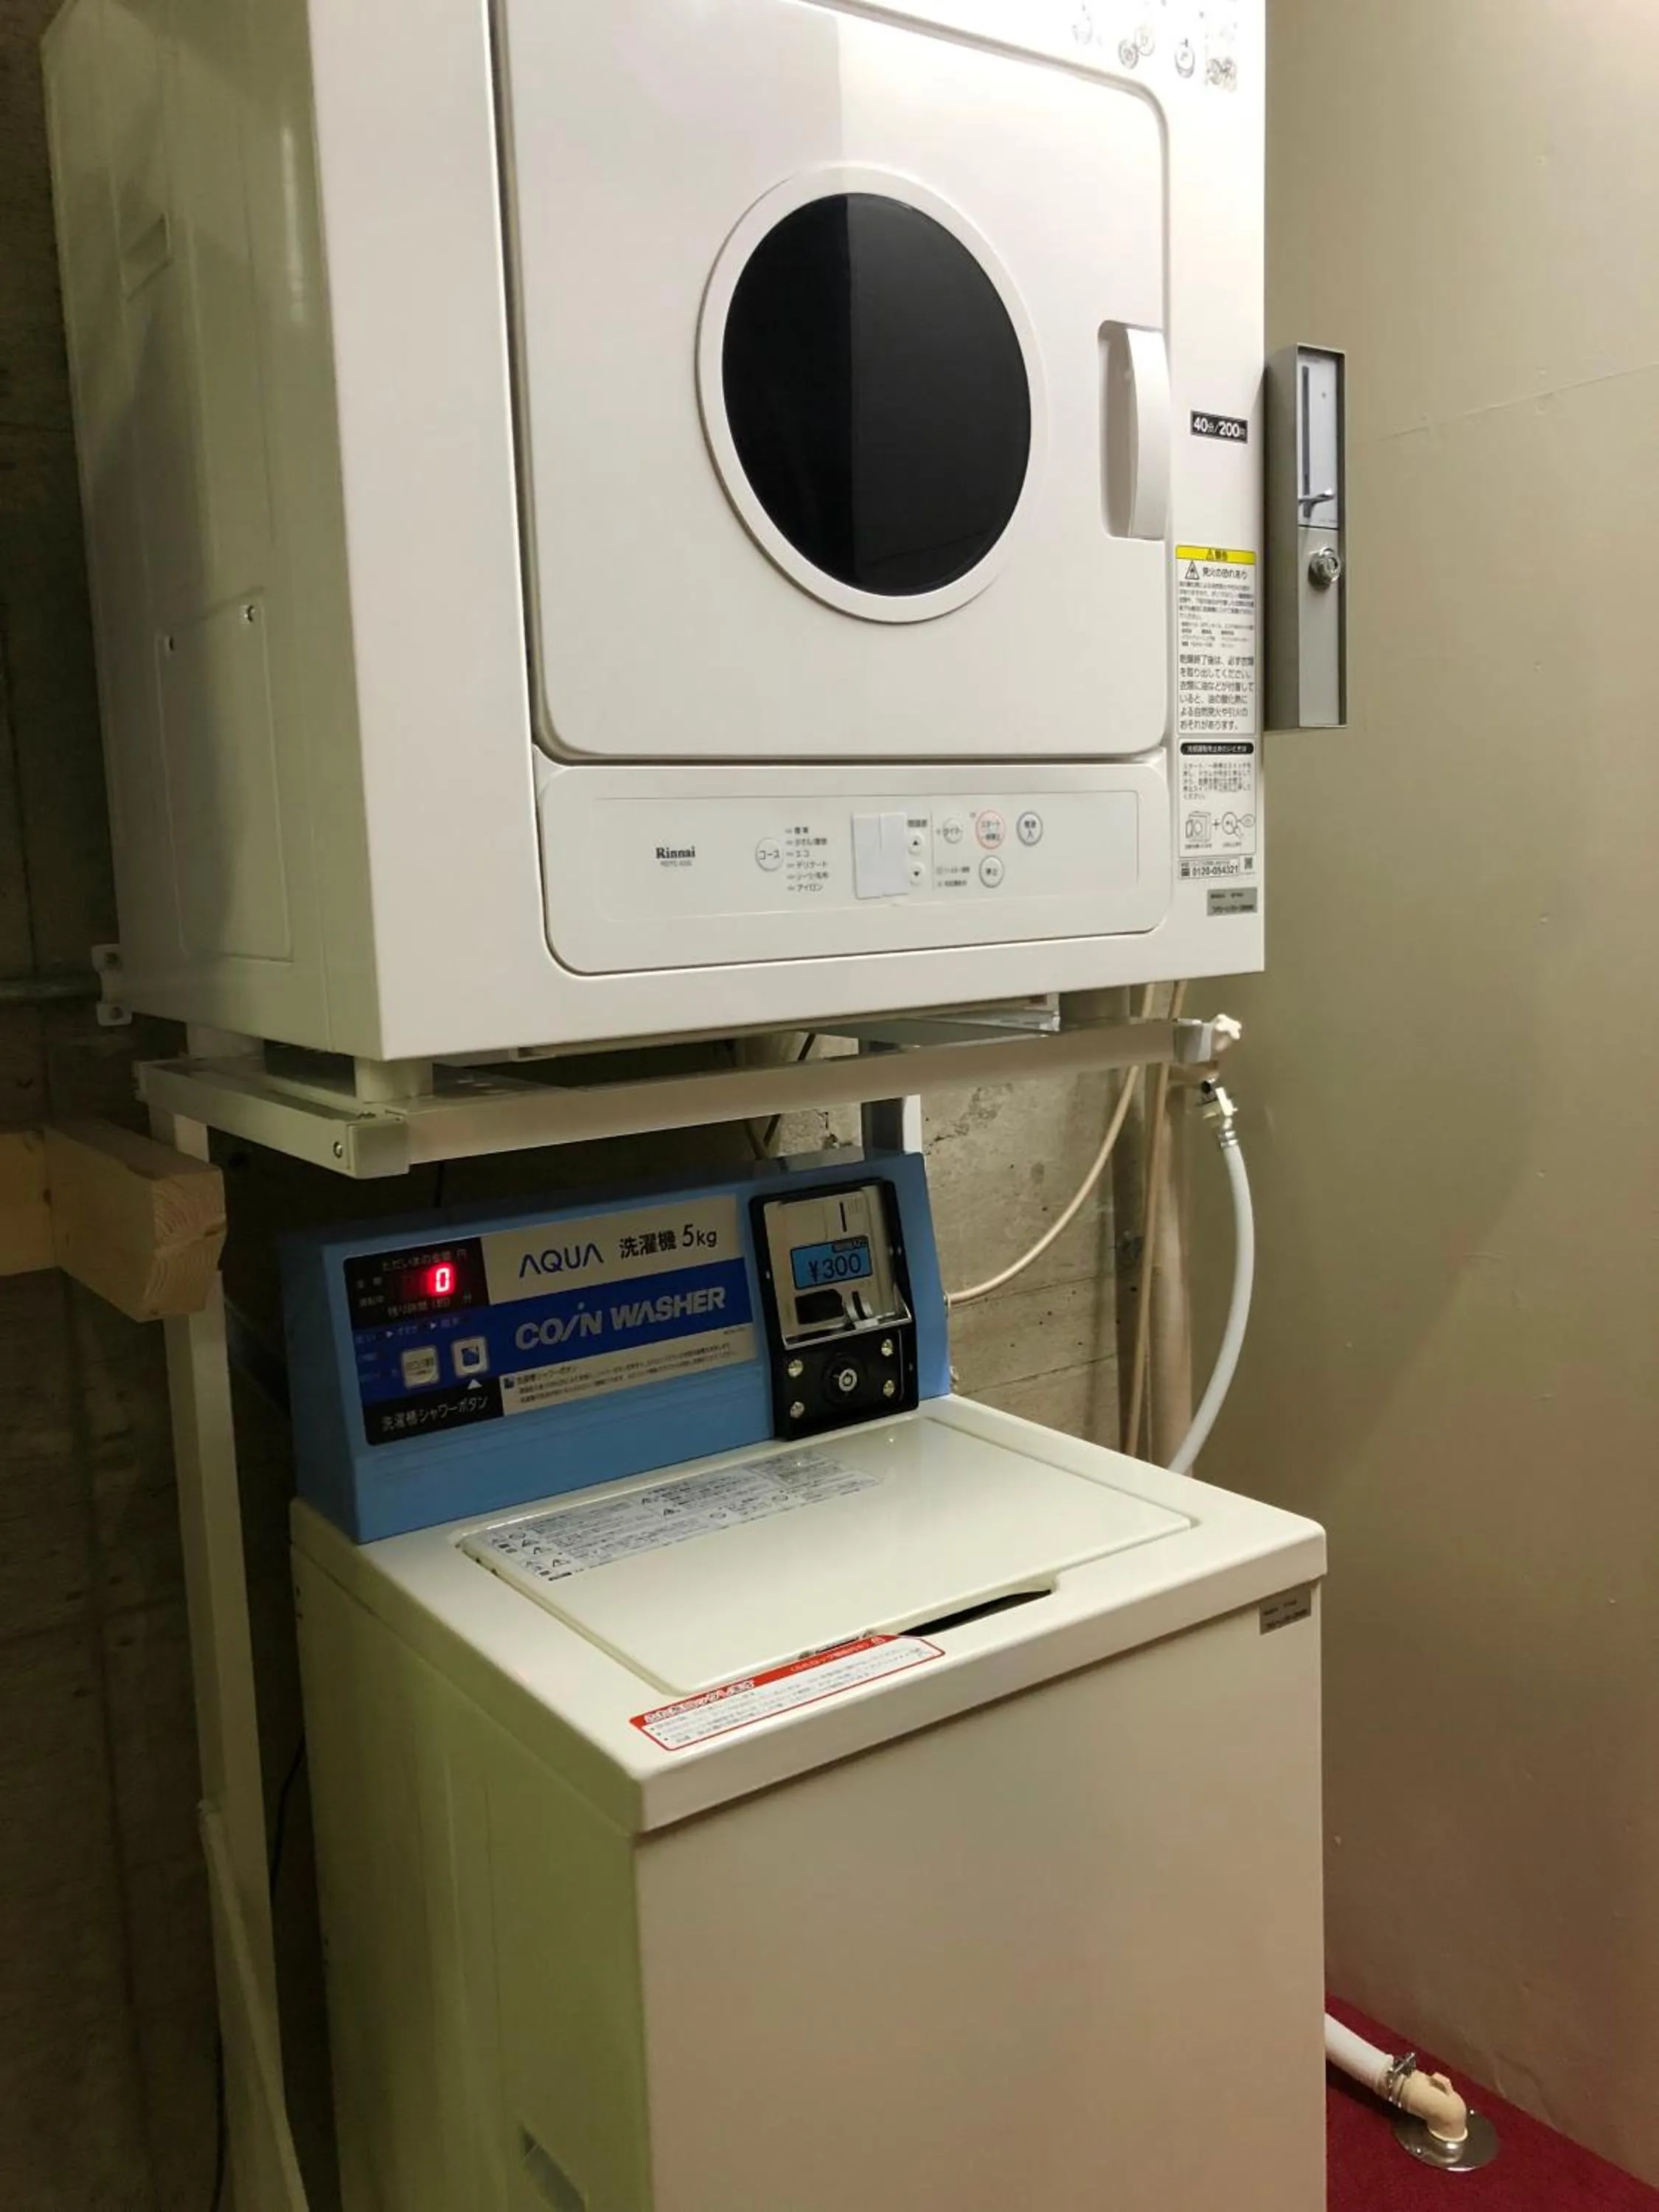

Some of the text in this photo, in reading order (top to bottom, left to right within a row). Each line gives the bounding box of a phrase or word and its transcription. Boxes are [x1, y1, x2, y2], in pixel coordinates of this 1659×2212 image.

[655, 846, 695, 859] Rinnai
[759, 849, 780, 860] コース
[619, 1223, 717, 1260] 洗濯機 5kg
[518, 1242, 604, 1279] AQUA
[808, 1253, 862, 1282] ¥300
[435, 1267, 451, 1293] 0
[515, 1286, 726, 1351] COIN WASHER
